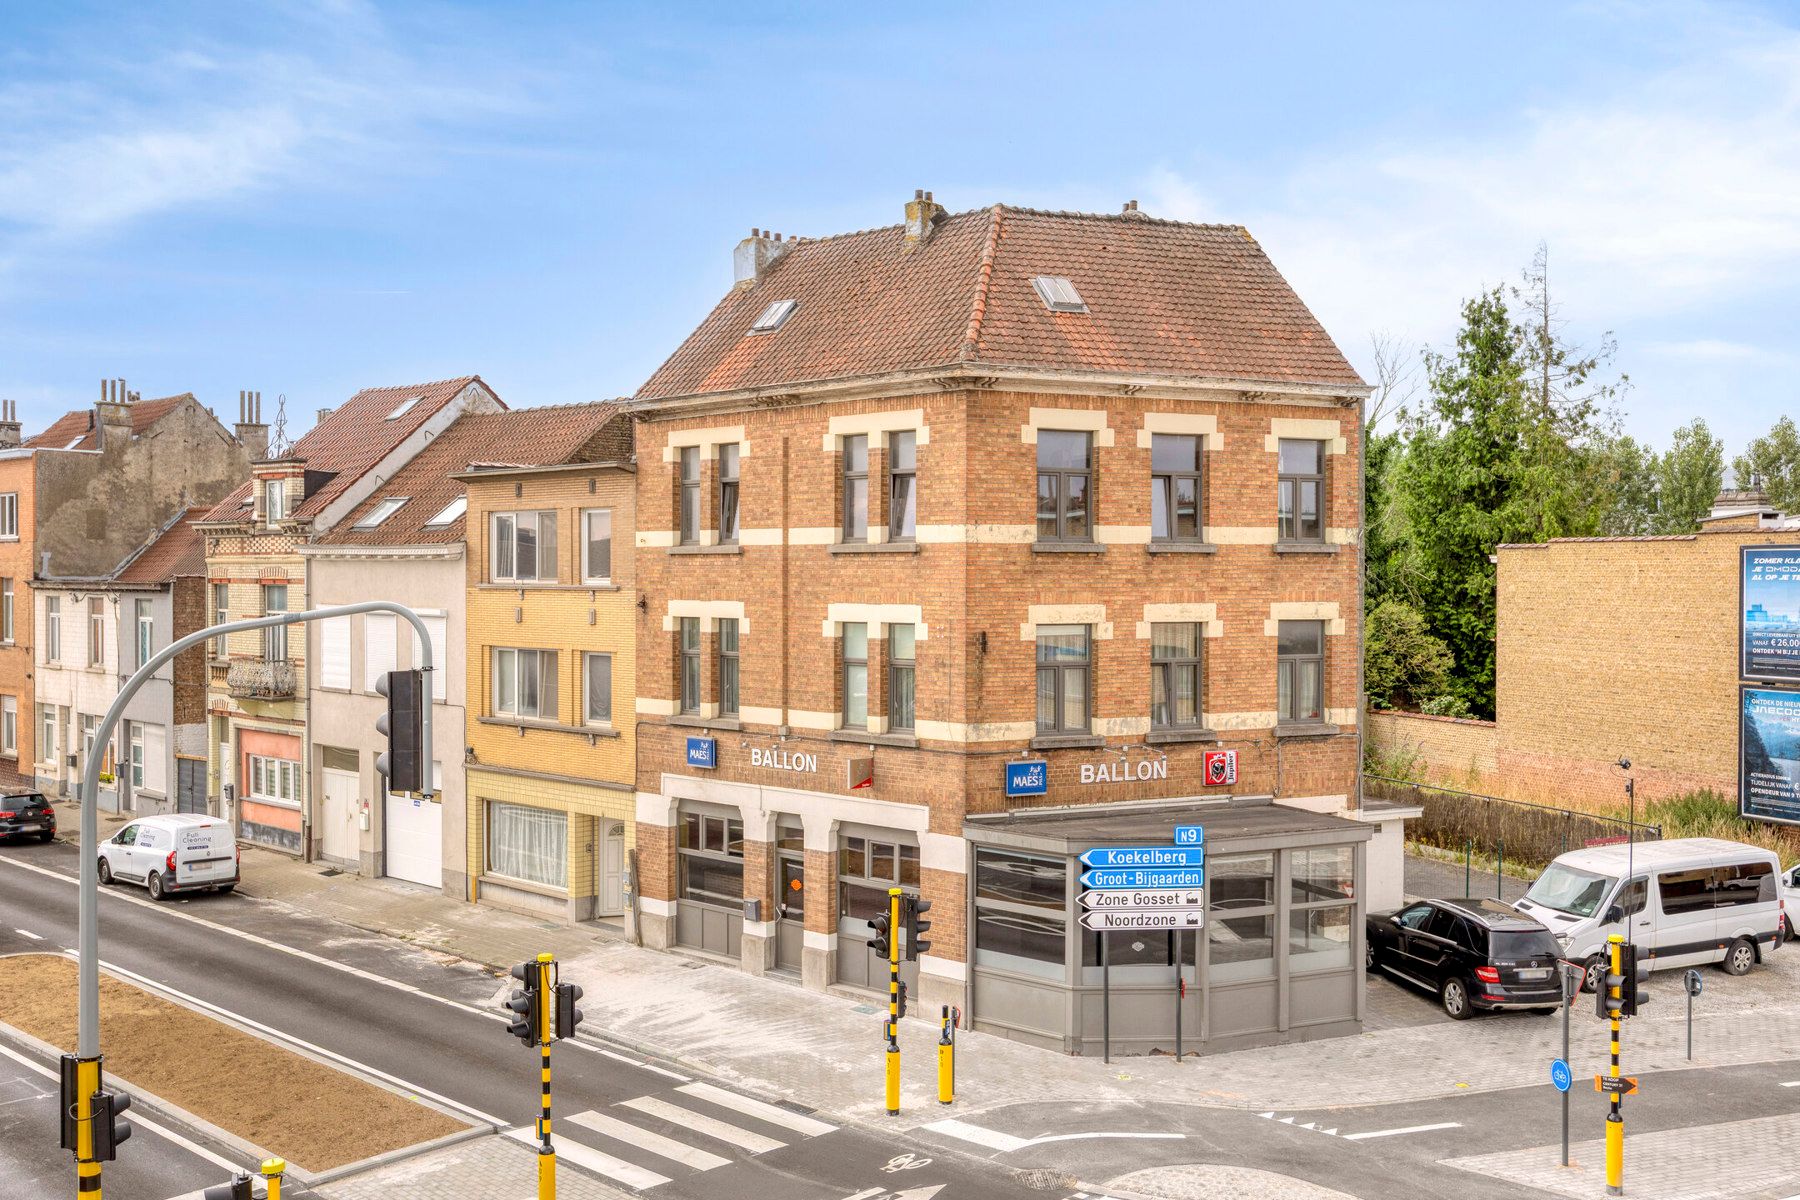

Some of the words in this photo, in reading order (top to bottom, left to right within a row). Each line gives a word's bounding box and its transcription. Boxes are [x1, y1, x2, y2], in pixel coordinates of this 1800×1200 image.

[690, 749, 706, 760] MAES
[752, 748, 816, 772] BALLON
[1080, 760, 1167, 784] BALLON
[1013, 776, 1038, 787] MAES
[1751, 780, 1775, 788] TIJDELIJK
[1751, 788, 1779, 796] OPENDEUR
[1181, 829, 1197, 842] N9
[1108, 850, 1186, 866] Koekelberg
[1095, 871, 1198, 887] Groot-Bijgaarden
[1096, 894, 1128, 906] Zone
[1134, 892, 1180, 905] Gosset
[1105, 914, 1176, 926] Noordzone
